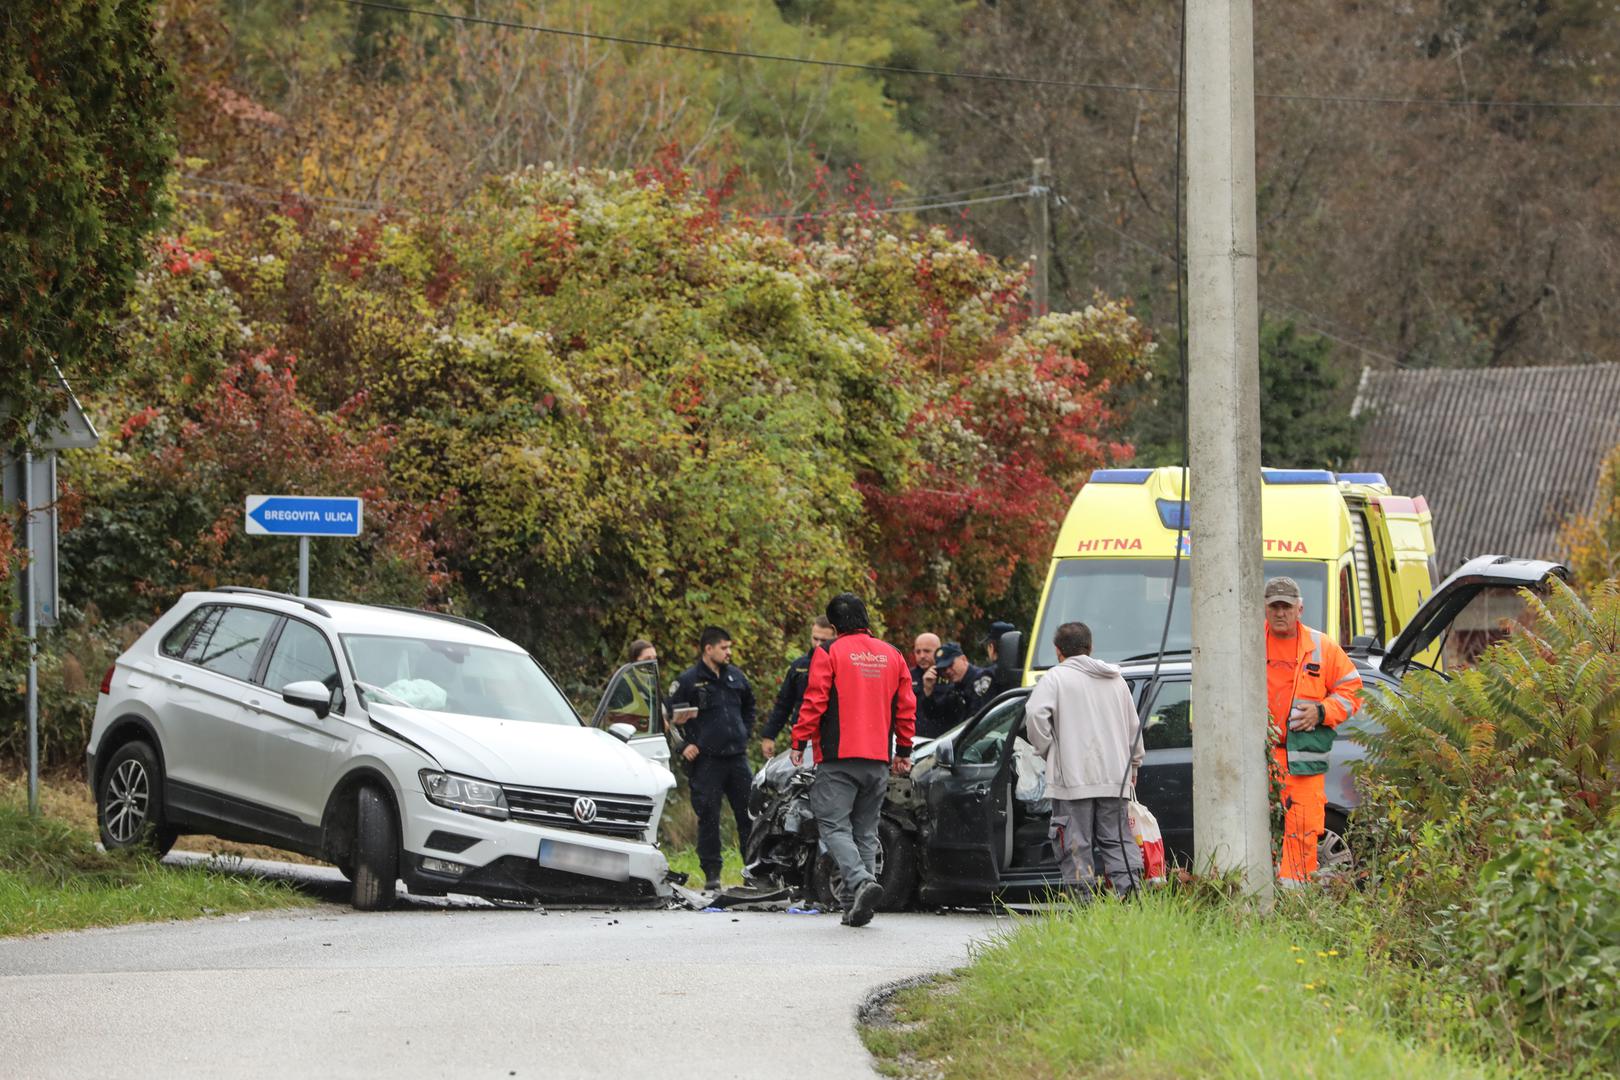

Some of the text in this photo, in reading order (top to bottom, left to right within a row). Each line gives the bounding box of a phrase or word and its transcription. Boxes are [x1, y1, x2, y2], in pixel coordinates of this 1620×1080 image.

[264, 510, 353, 522] BREGOVITA ULICA
[1077, 538, 1142, 552] HITNA
[1263, 539, 1308, 554] TNA
